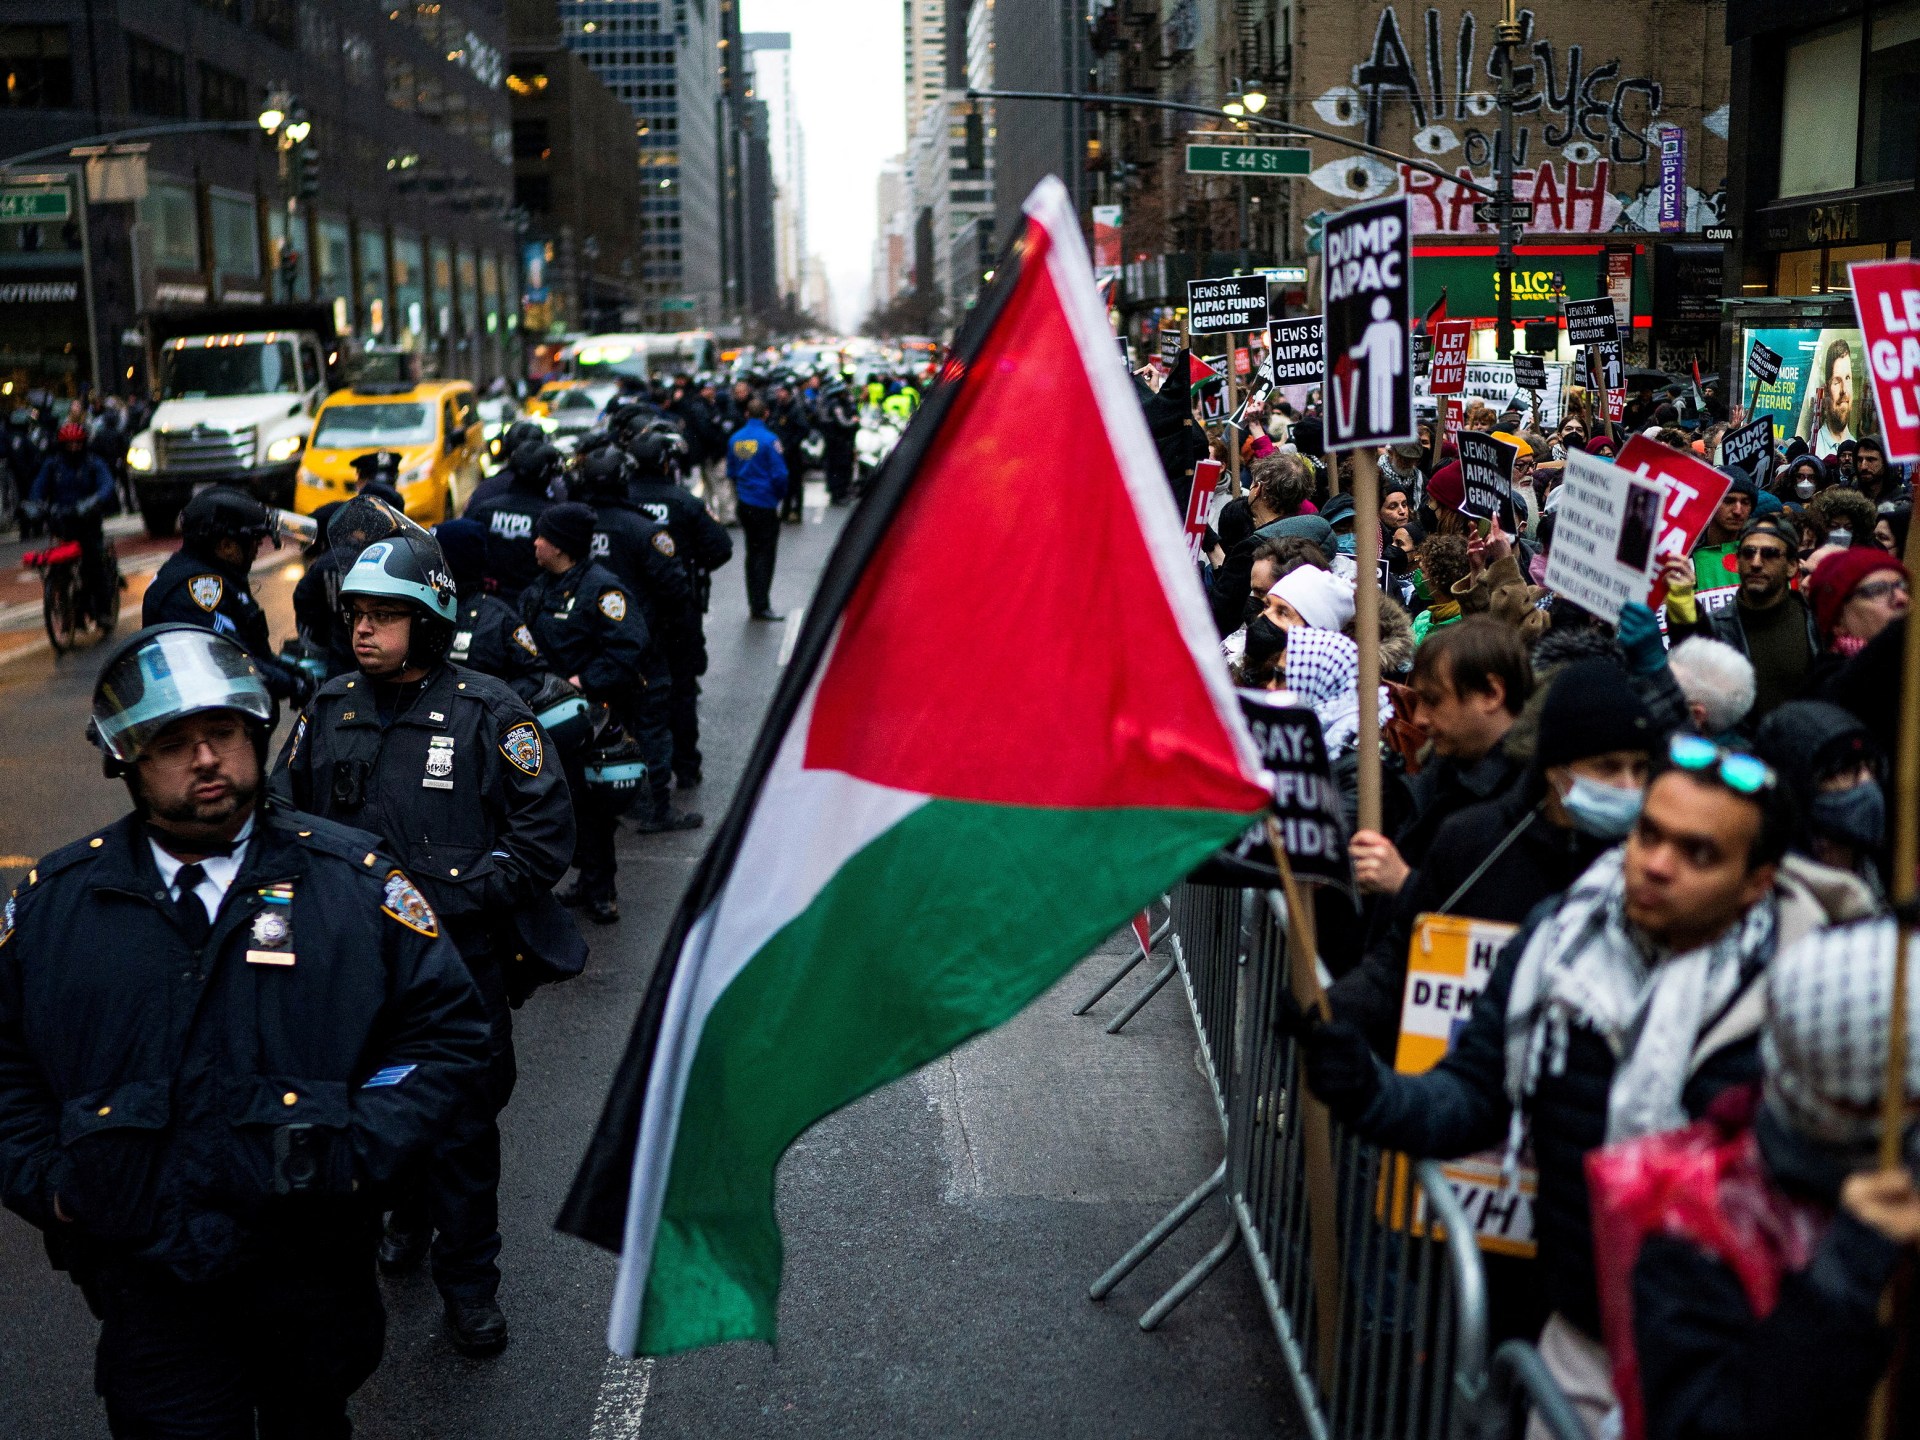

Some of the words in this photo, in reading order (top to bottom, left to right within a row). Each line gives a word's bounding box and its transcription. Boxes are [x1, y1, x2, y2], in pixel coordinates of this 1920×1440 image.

[1222, 151, 1230, 168] E
[1236, 153, 1256, 168] 44
[1262, 153, 1277, 169] St
[1663, 166, 1676, 219] PHONES
[1328, 216, 1402, 267] DUMP
[1706, 229, 1733, 240] CAVA
[1328, 251, 1402, 302] AIPAC
[1193, 286, 1219, 299] JEWS
[1220, 283, 1241, 296] SAY:
[1193, 300, 1226, 314] AIPAC
[1227, 296, 1266, 311] FUNDS
[1568, 306, 1584, 317] JEWS
[1584, 304, 1597, 315] SAY:
[1878, 288, 1920, 334] LE
[1193, 312, 1249, 328] GENOCIDE
[1569, 318, 1588, 329] AIPAC
[1589, 314, 1614, 327] FUNDS
[1274, 326, 1308, 343] JEWS
[1310, 324, 1324, 339] SA
[1442, 333, 1466, 349] LET
[1571, 328, 1605, 341] GENOCIDE
[1276, 344, 1319, 361] AIPAC
[1434, 349, 1466, 366] GAZA
[1588, 343, 1619, 355] APAC
[1872, 336, 1920, 382] GA
[1277, 360, 1324, 378] GENOC
[1435, 367, 1462, 384] LIVE
[1779, 366, 1799, 380] MORE
[1782, 381, 1796, 394] FOR
[1752, 393, 1793, 411] ETERANS
[1445, 420, 1462, 431] AZA
[1725, 421, 1768, 455] DUMP
[1463, 441, 1488, 461] JEWS
[1728, 432, 1769, 466] AIPAC
[1466, 463, 1494, 487] AIPAC
[491, 511, 532, 533] NYPD
[504, 730, 534, 750] DEPARTMENT
[506, 727, 526, 740] POLICE
[1413, 978, 1479, 1014] DEM
